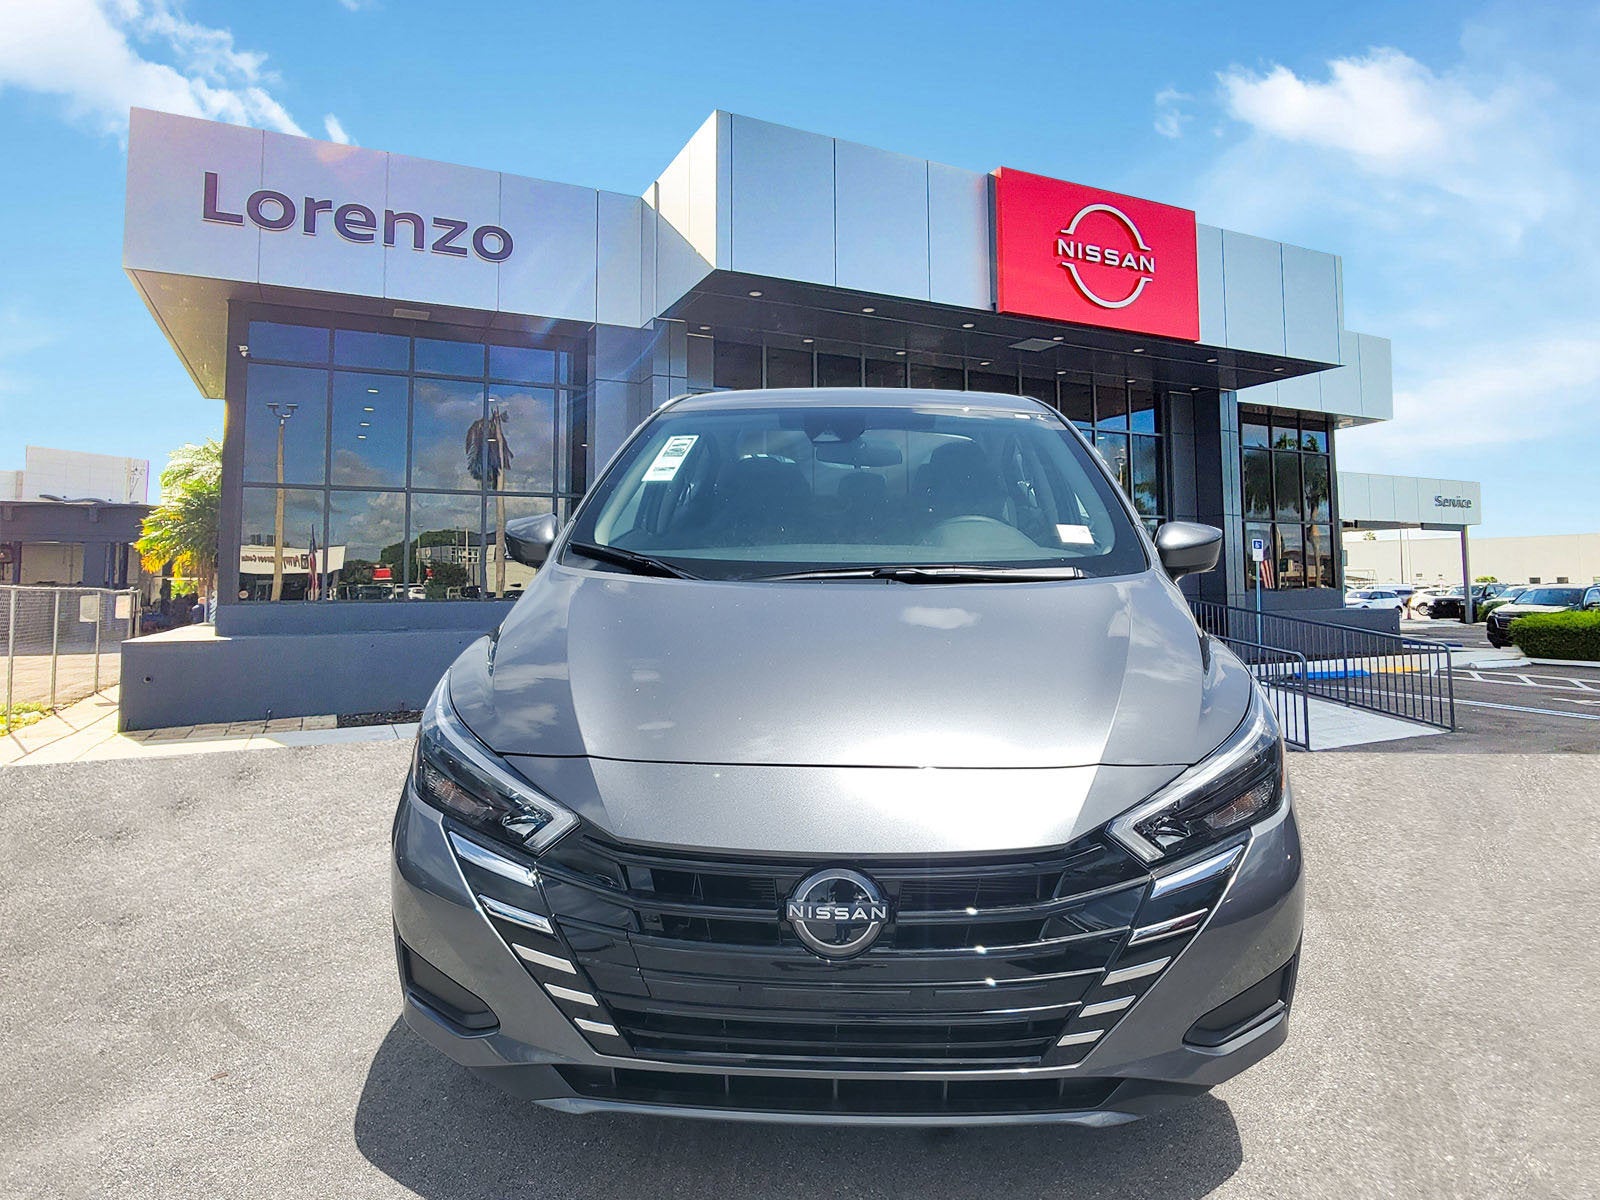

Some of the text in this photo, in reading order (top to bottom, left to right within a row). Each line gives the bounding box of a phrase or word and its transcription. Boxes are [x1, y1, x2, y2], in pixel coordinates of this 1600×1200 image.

[203, 171, 514, 262] Lorenzo
[1057, 238, 1155, 273] NISSAN
[1434, 495, 1472, 509] Service
[789, 904, 887, 920] NISSAN
